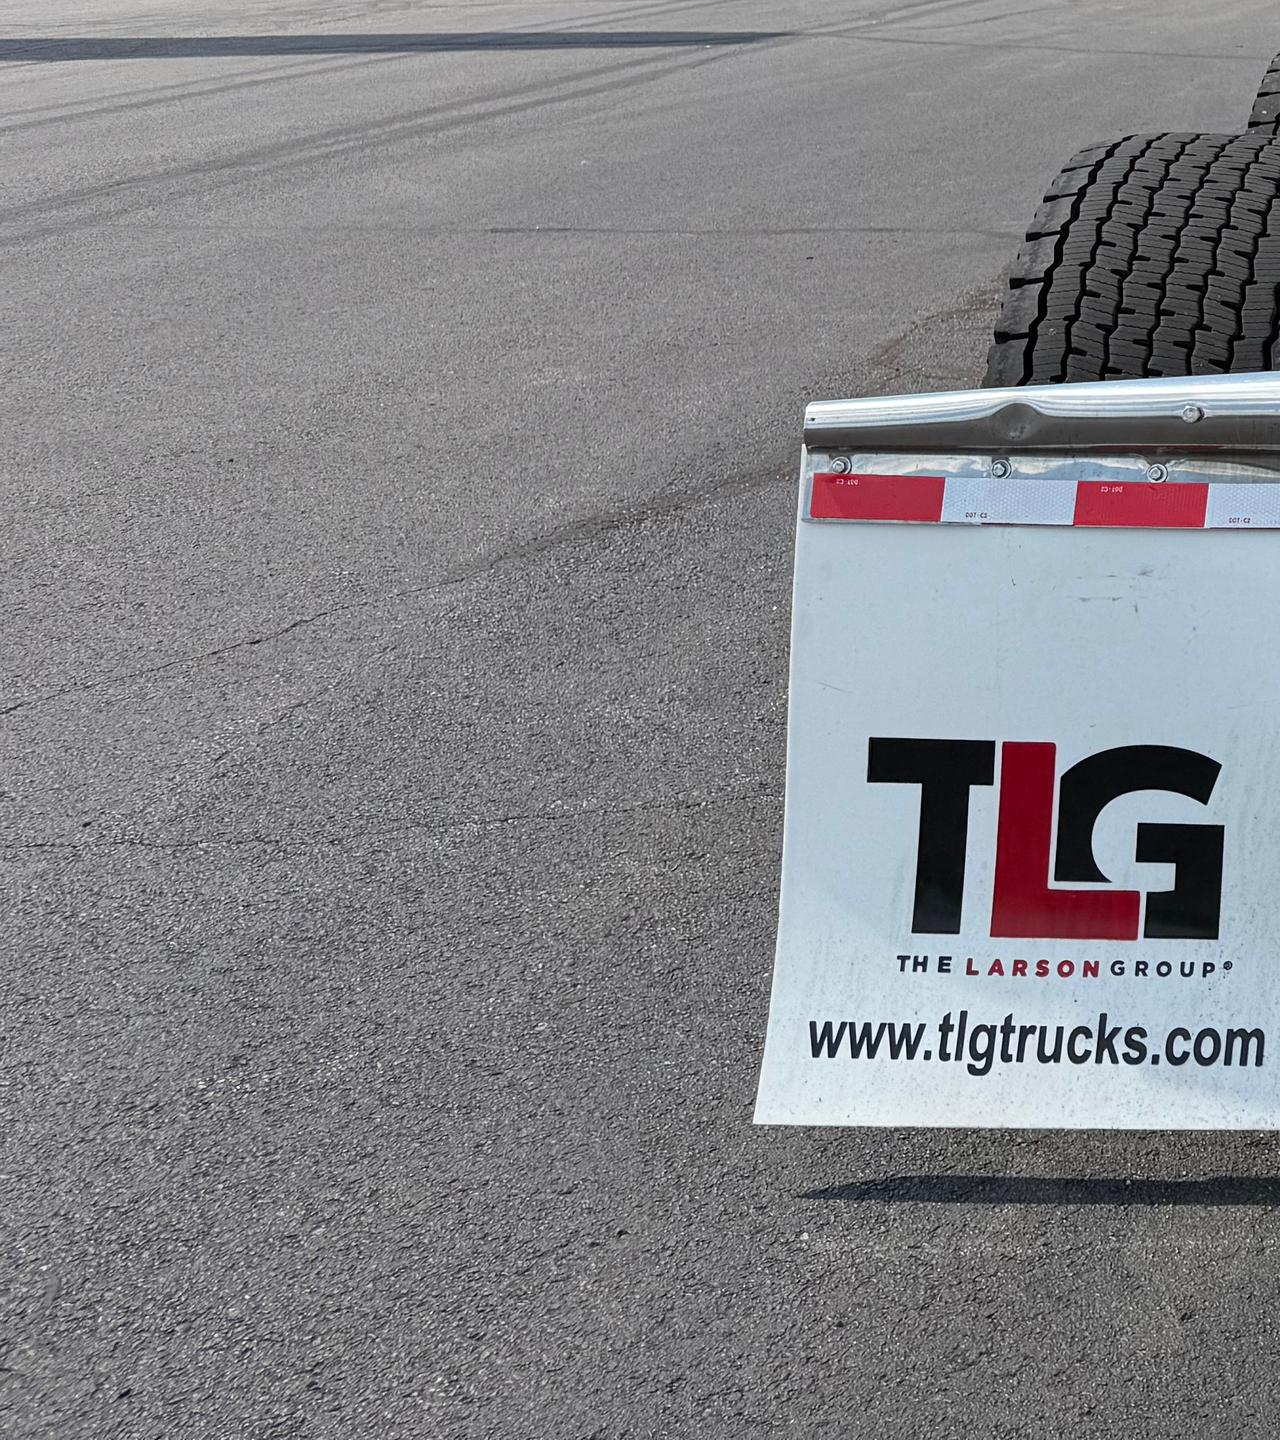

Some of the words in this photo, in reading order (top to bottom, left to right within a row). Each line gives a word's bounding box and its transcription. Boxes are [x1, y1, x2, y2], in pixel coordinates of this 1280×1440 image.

[866, 737, 1225, 941] TLG
[897, 955, 952, 974] THE
[966, 959, 1100, 978] LARSON
[809, 1010, 1266, 1077] www.tlgtrucks.com
